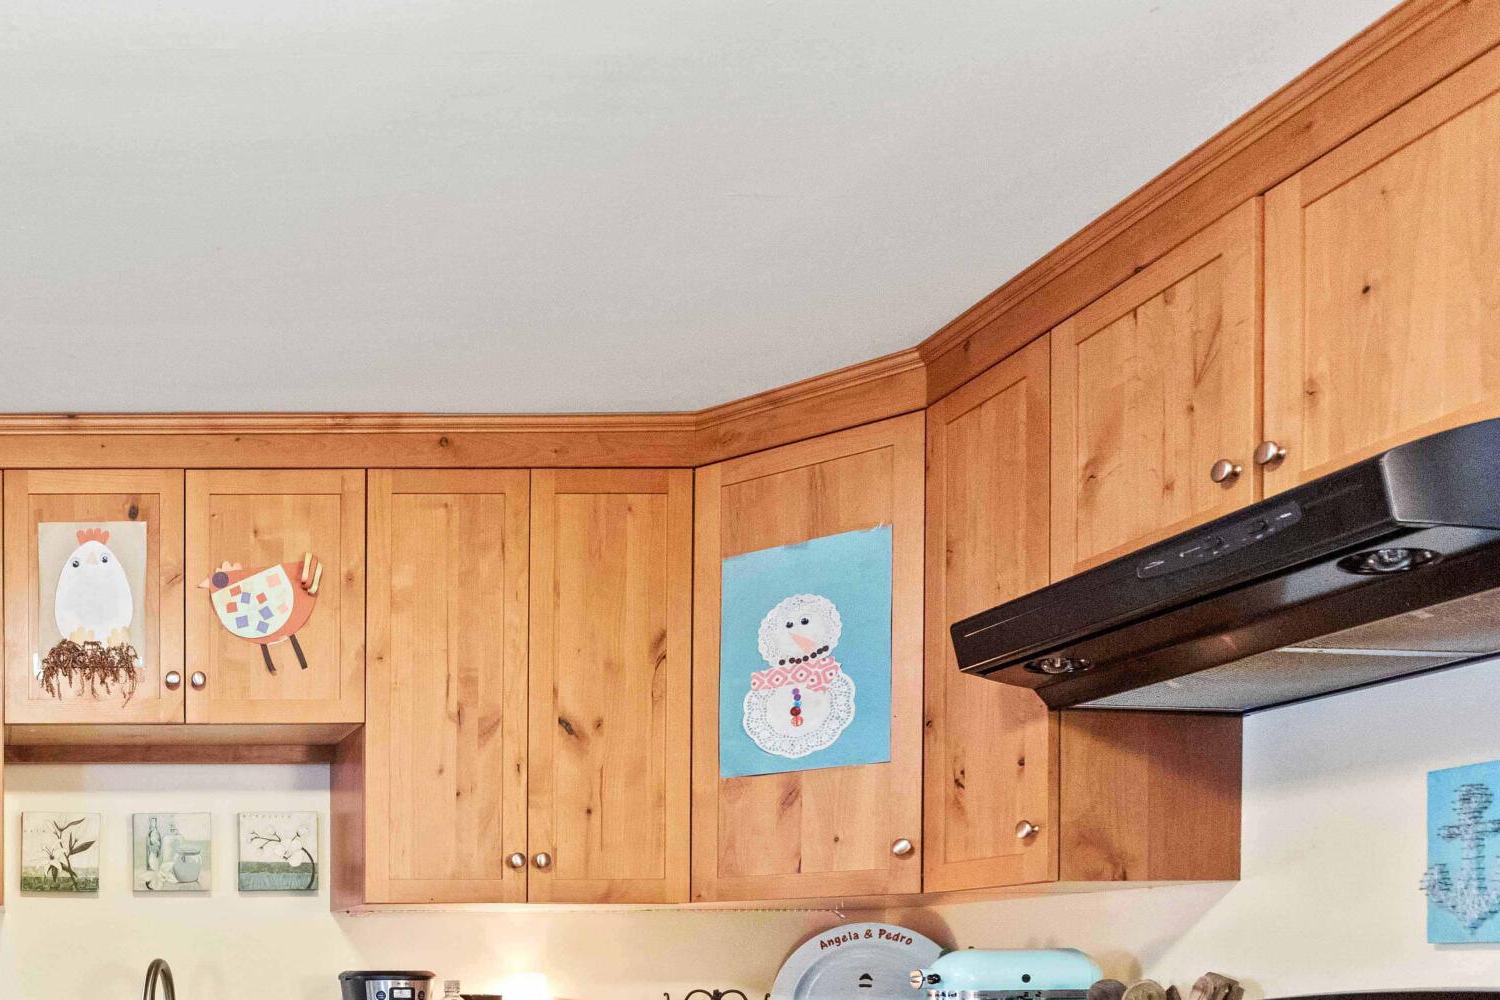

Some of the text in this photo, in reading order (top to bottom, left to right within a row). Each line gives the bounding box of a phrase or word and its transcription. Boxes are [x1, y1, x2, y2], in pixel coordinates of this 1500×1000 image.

[819, 928, 913, 950] Angela & Pedro
